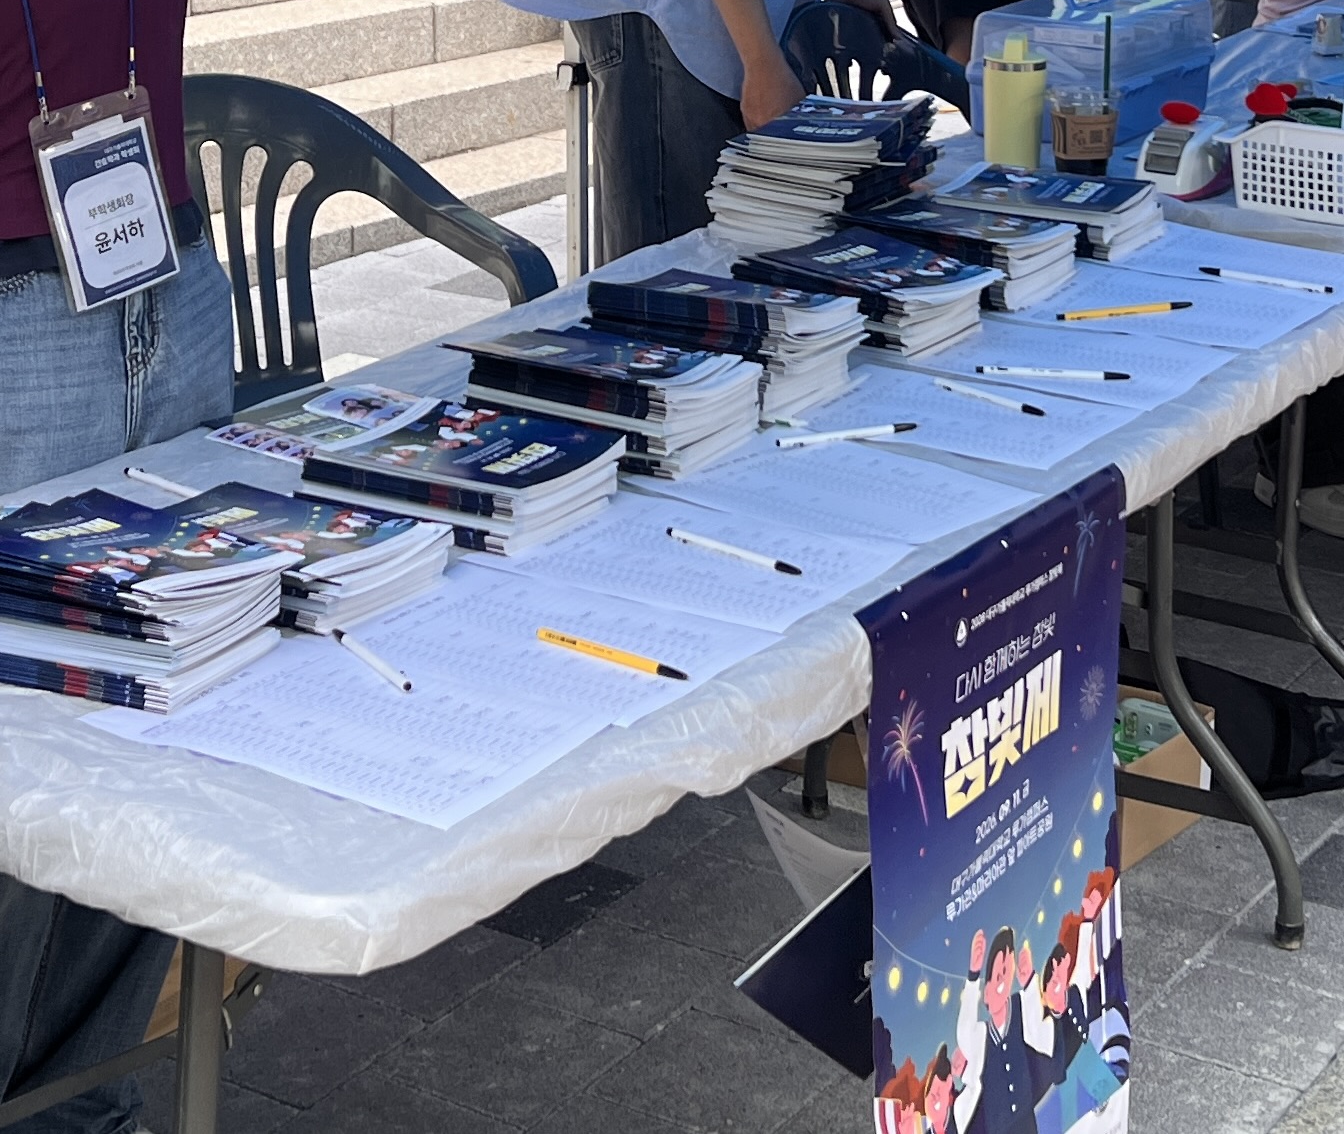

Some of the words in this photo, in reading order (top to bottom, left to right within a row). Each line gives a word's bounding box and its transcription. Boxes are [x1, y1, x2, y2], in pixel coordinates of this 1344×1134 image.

[87, 192, 135, 219] 부학생회장
[94, 216, 145, 255] 윤서하
[955, 662, 983, 704] 다시
[983, 634, 1031, 684] 함께하는
[1031, 611, 1056, 650] 참빛
[941, 649, 1063, 820] 참빛제
[1012, 795, 1049, 838] 루가캠퍼스
